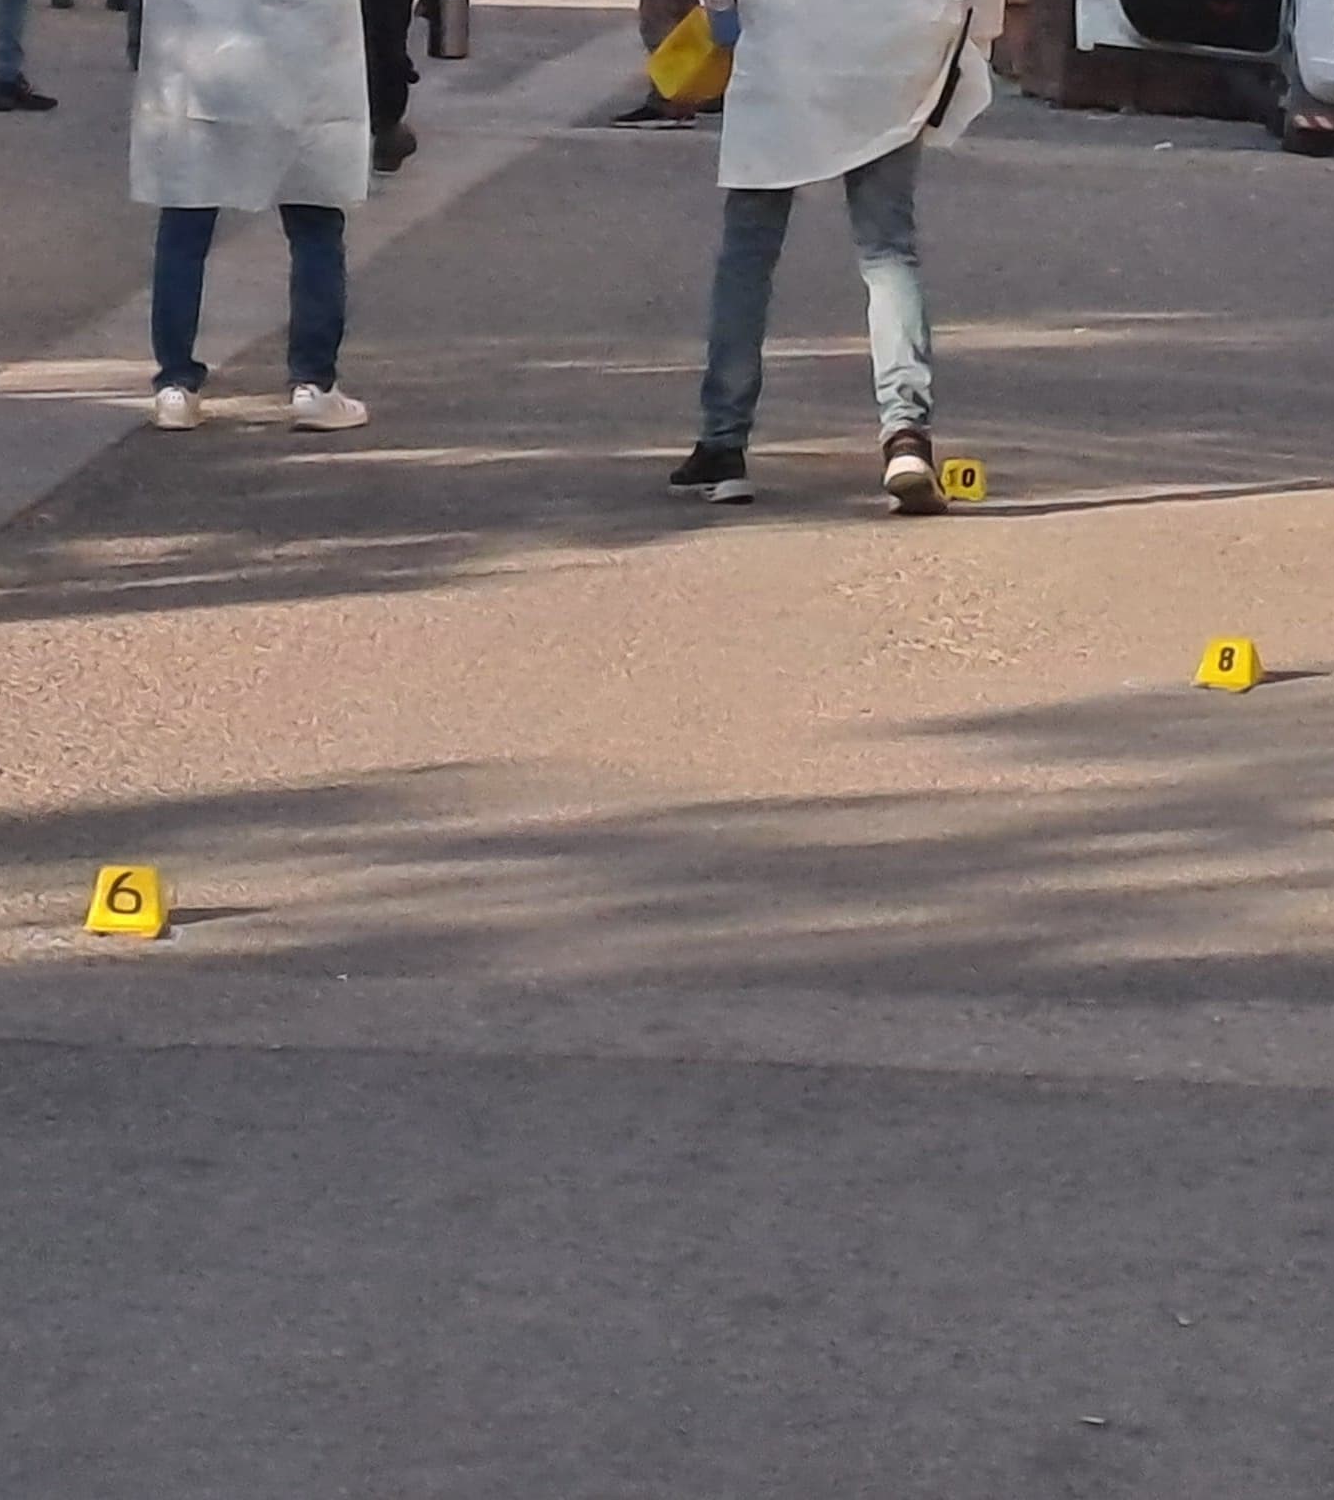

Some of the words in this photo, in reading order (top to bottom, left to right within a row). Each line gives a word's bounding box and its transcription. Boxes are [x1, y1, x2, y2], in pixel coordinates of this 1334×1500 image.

[945, 467, 976, 488] 10
[1217, 646, 1236, 672] 8
[105, 871, 143, 915] 6
